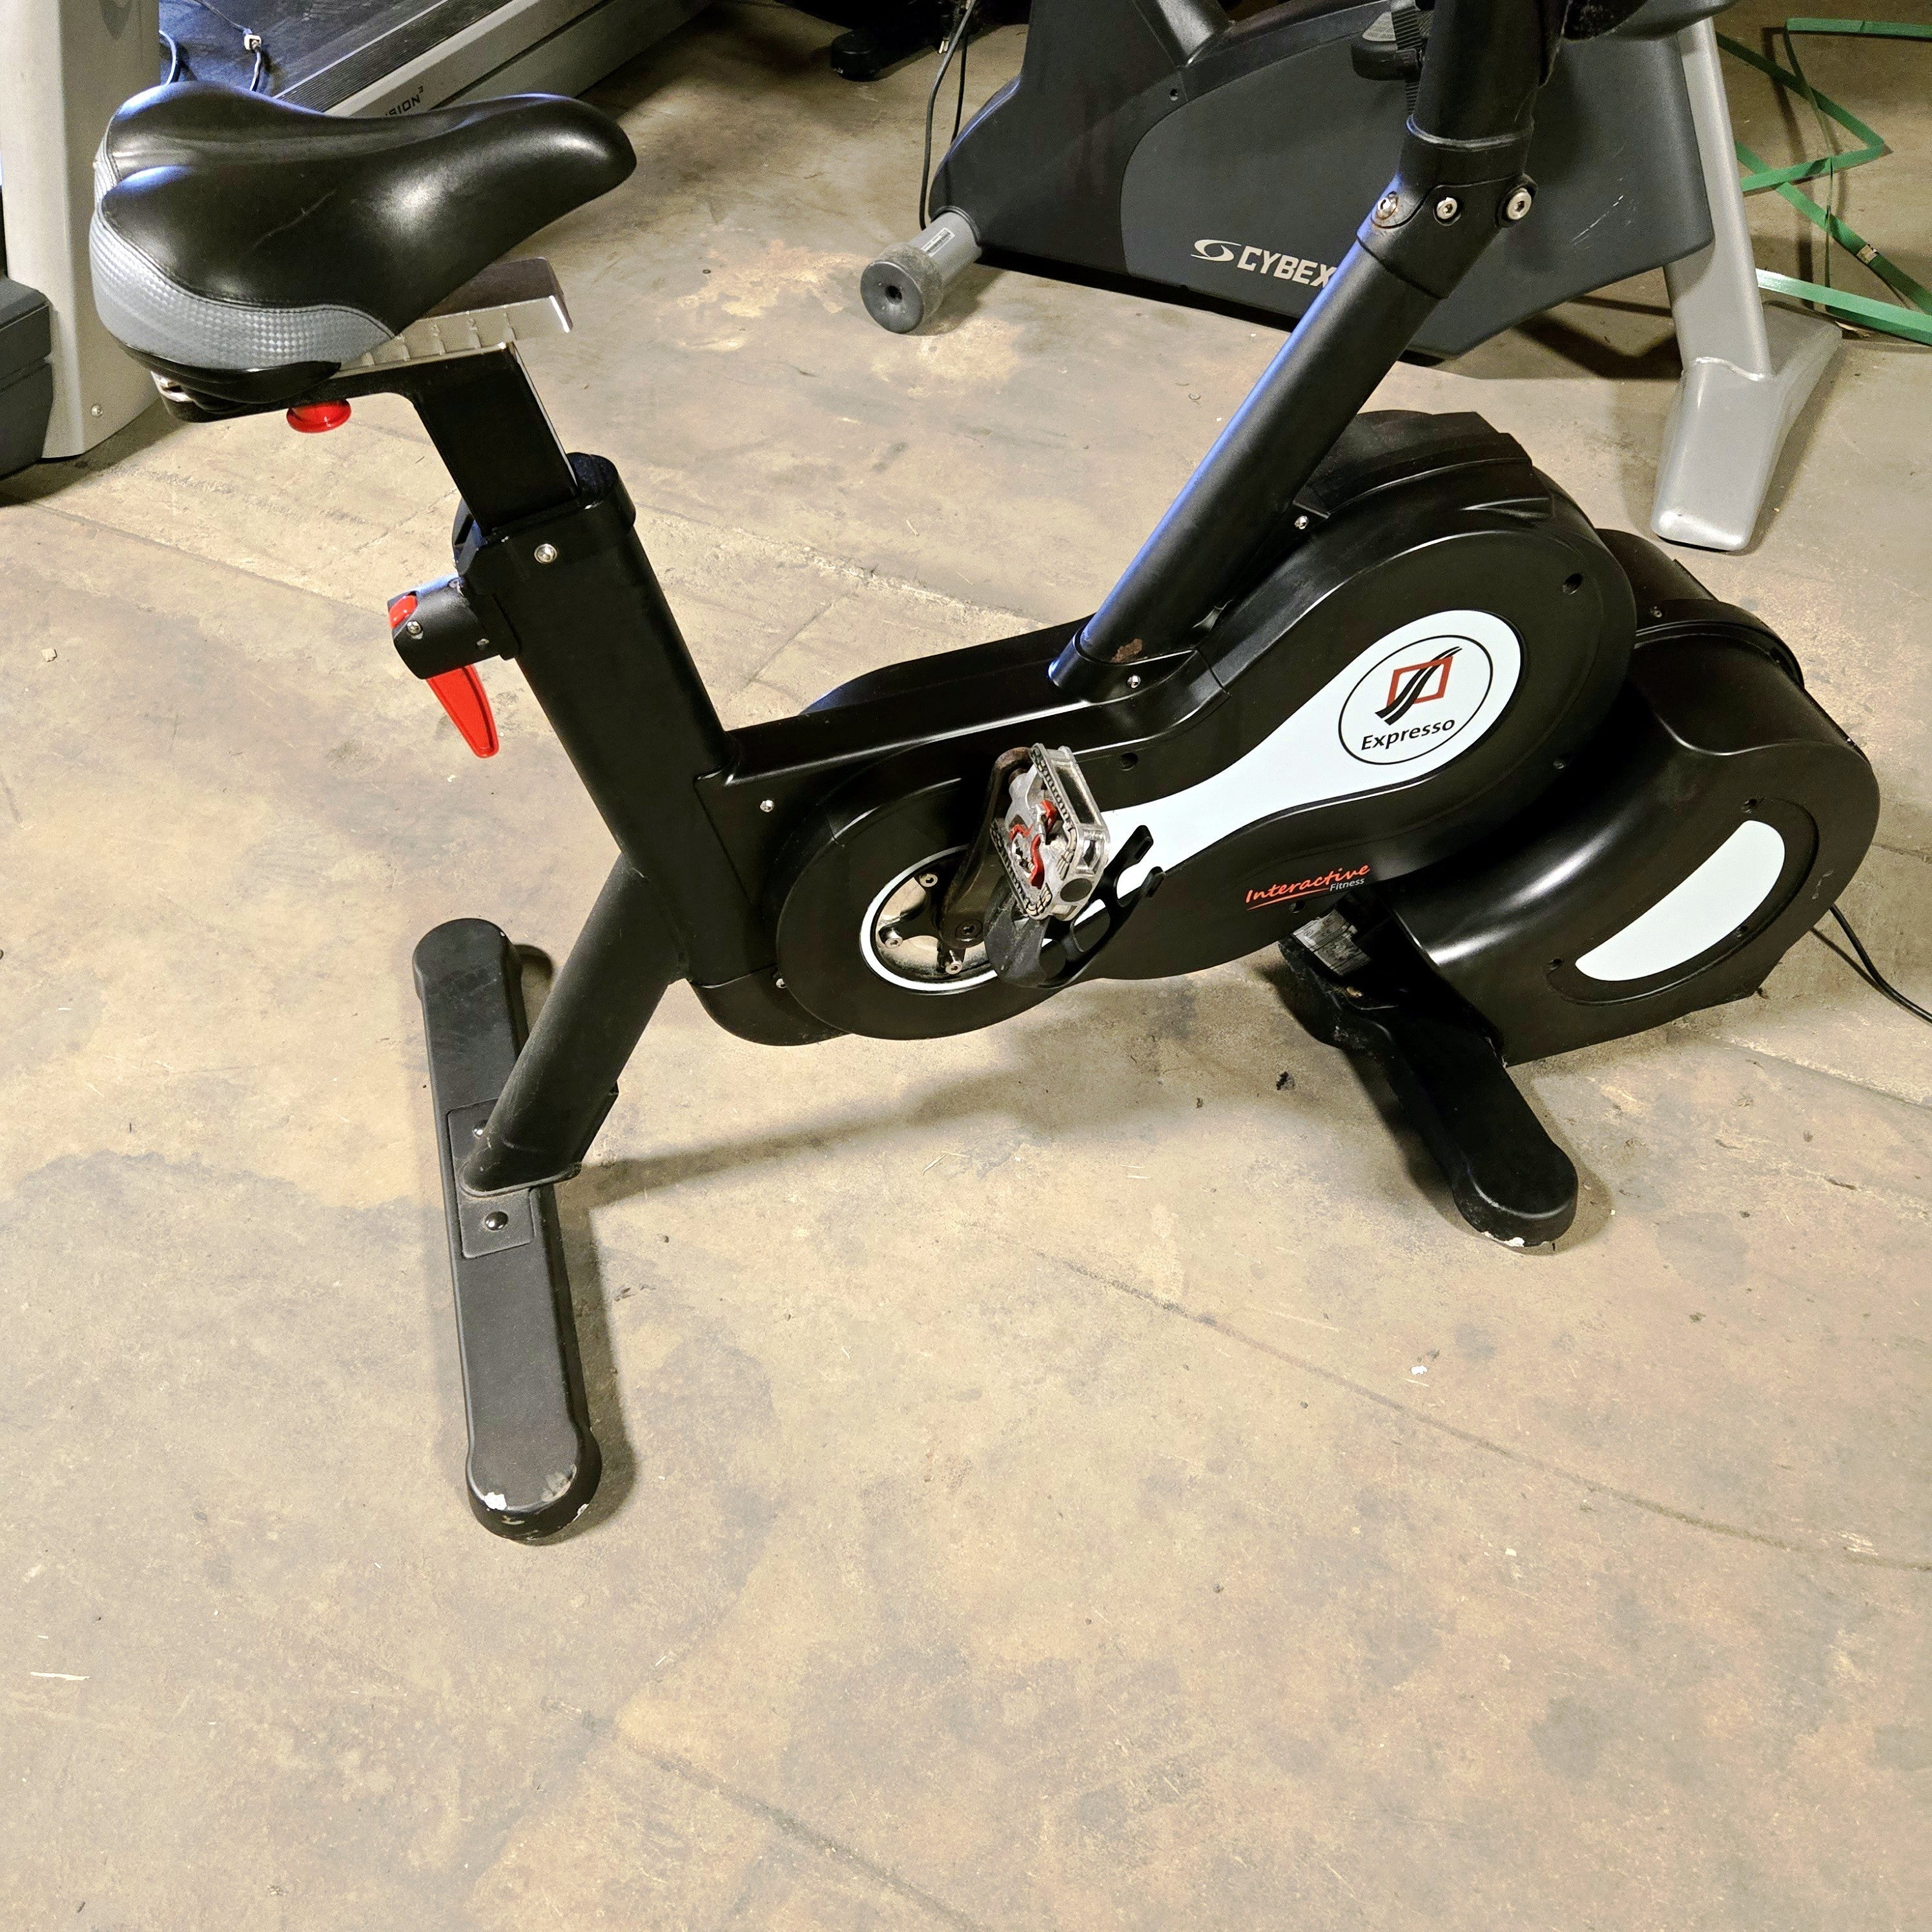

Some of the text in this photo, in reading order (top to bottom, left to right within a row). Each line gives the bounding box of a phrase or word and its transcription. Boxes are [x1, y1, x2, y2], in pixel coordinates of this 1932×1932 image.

[1237, 245, 1337, 288] CYBEX
[1361, 719, 1455, 750] Expresso
[1246, 865, 1370, 903] Interactive
[1330, 878, 1365, 892] Fitness
